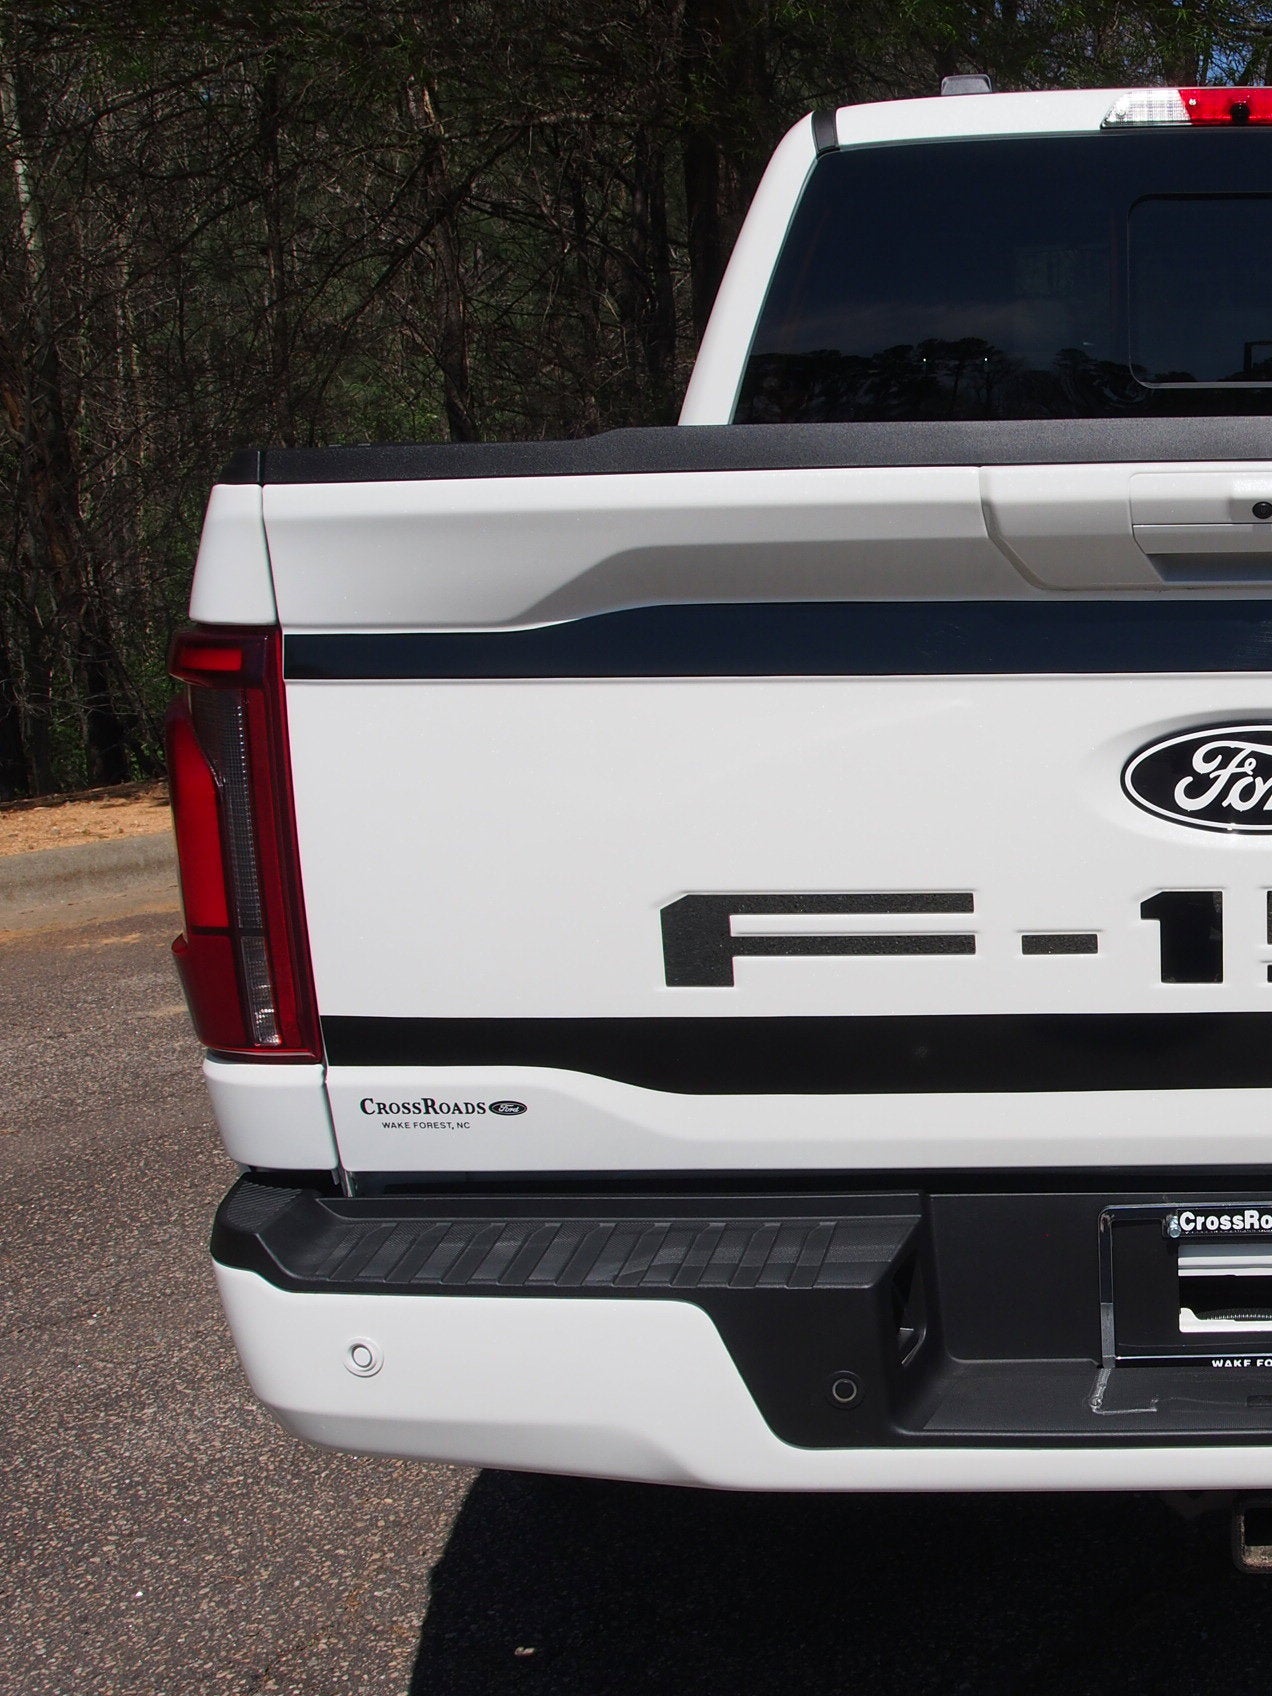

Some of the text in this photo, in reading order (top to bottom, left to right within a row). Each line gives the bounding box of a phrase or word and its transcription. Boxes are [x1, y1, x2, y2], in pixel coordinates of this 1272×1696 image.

[382, 1121, 471, 1130] WAKE FOREST, NC
